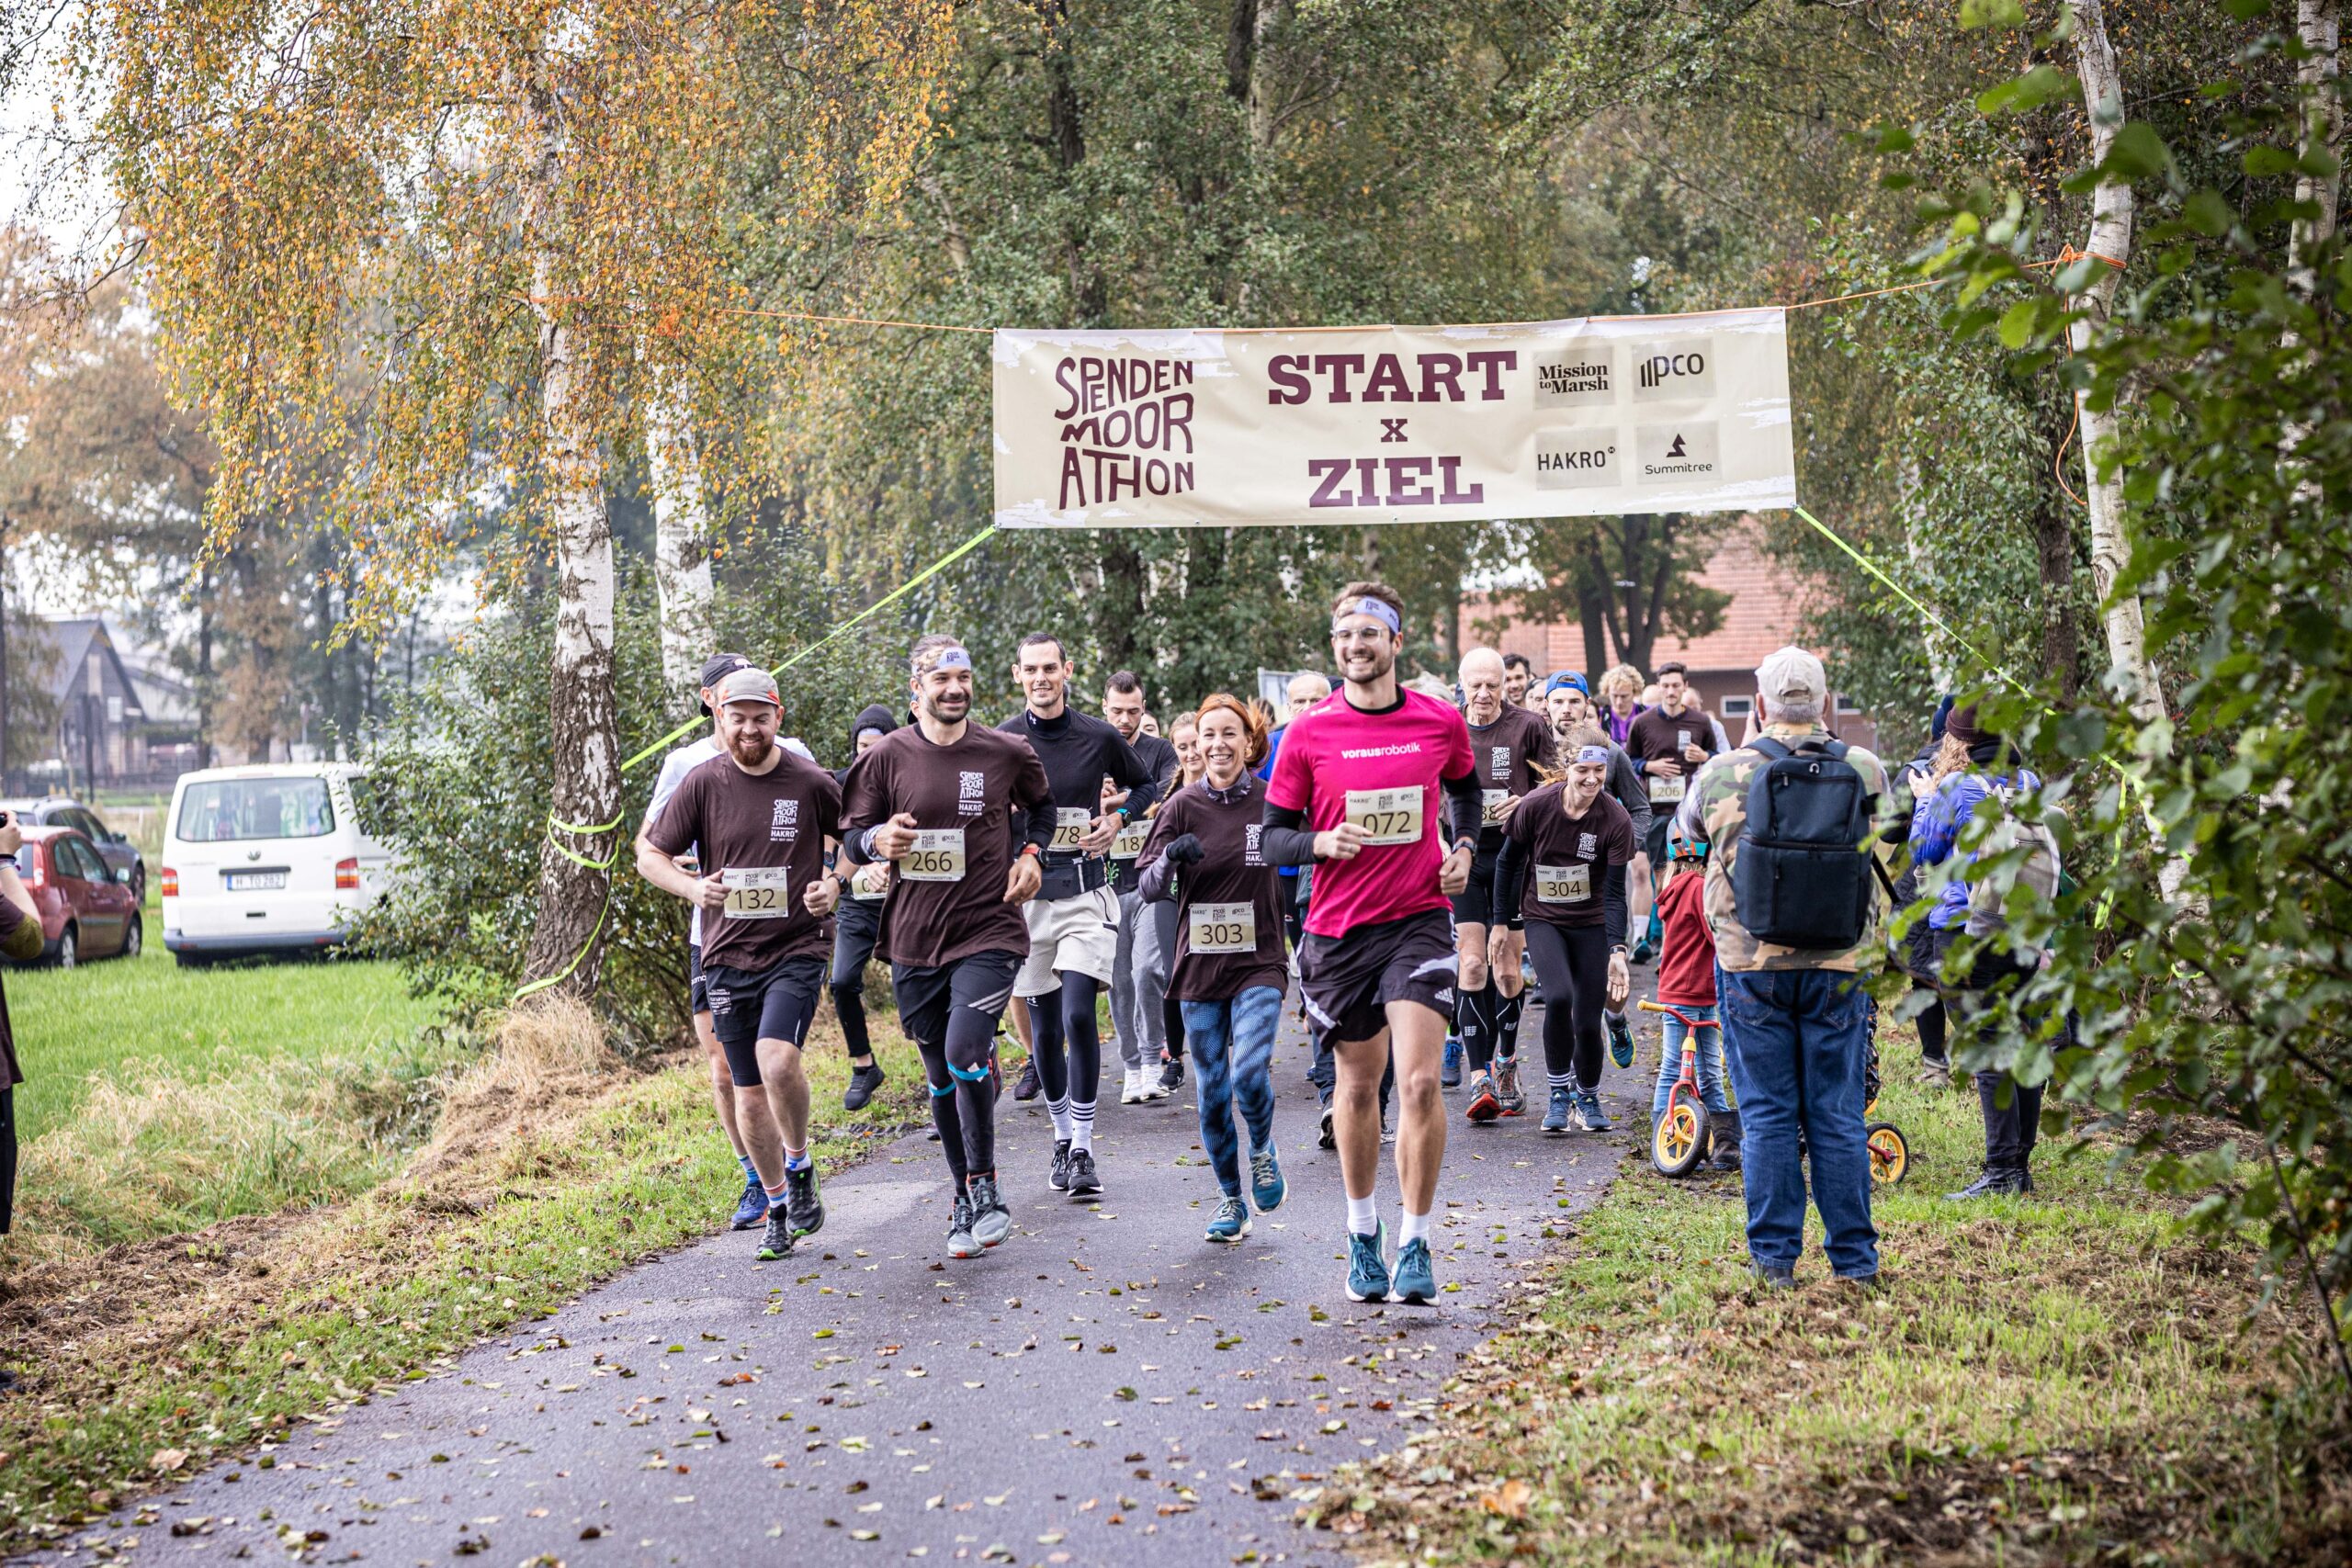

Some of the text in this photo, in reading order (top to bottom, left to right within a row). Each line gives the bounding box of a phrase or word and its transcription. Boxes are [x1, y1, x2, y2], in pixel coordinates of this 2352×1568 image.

[1268, 351, 1517, 404] START
[1539, 362, 1608, 379] Mission
[1055, 356, 1193, 420] SPENDEN
[1540, 377, 1609, 394] to Marsh
[1060, 392, 1194, 454] MOOR
[1537, 450, 1606, 470] HAKRO
[1645, 463, 1713, 475] Summitree
[1059, 446, 1194, 510] ATHON
[1308, 456, 1484, 507] ZIEL
[1341, 742, 1421, 759] vorausrobotik
[1657, 786, 1680, 797] 206
[958, 803, 982, 812] HAKRO
[1363, 811, 1412, 835] 072
[1120, 836, 1146, 852] 18
[910, 852, 953, 872] 266
[735, 888, 775, 909] 132
[1547, 881, 1582, 897] 304
[1201, 923, 1243, 944] 303
